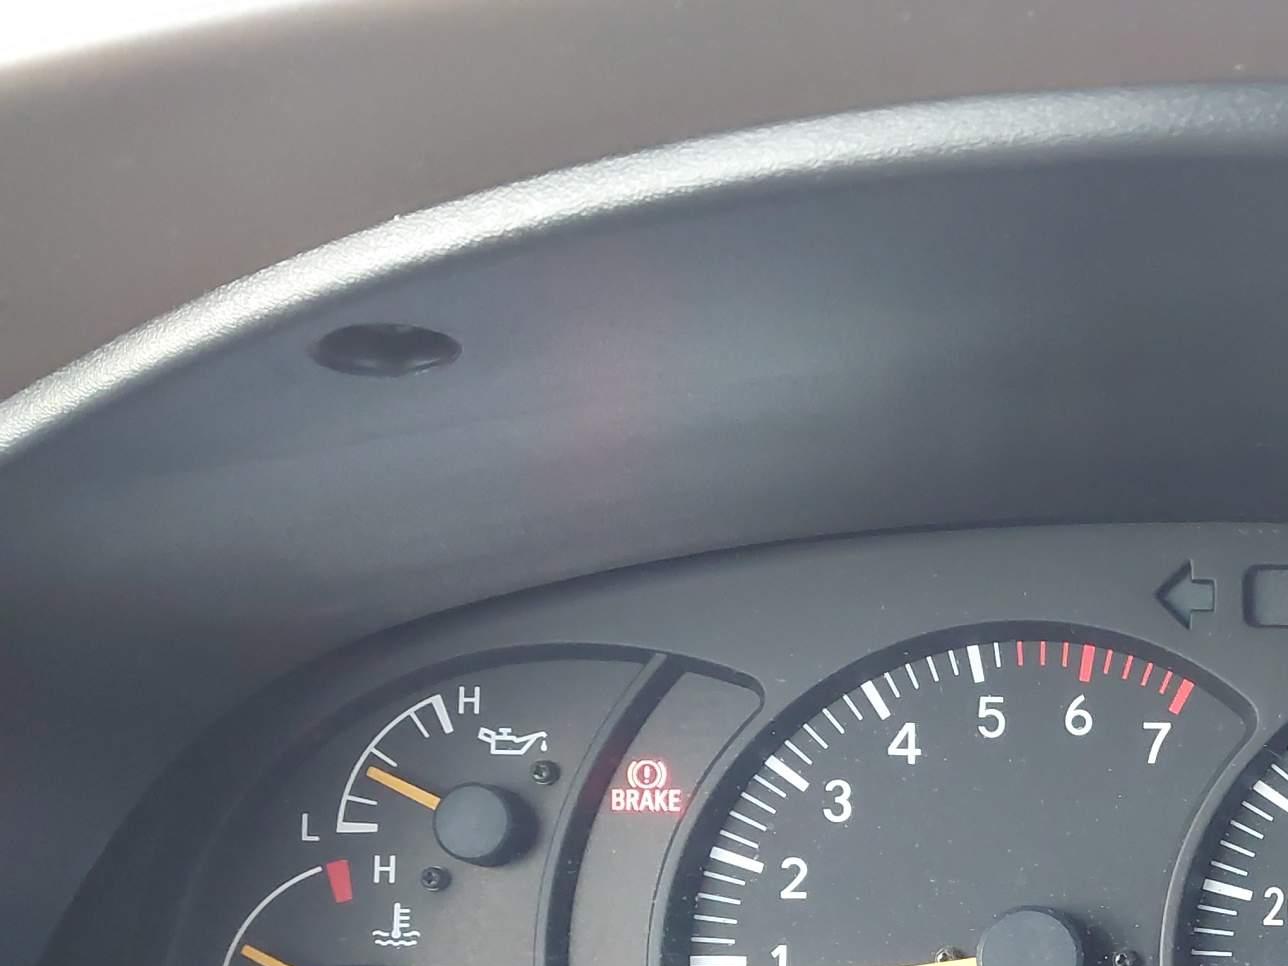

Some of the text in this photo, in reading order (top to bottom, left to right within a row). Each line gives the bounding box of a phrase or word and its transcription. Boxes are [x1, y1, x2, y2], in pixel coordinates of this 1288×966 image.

[459, 687, 480, 714] H
[979, 695, 1005, 738] 5
[1065, 695, 1092, 735] 6
[888, 723, 921, 764] 4
[1144, 722, 1171, 763] 7
[611, 788, 682, 812] BRAKE
[824, 780, 851, 822] 3
[302, 814, 320, 841] L
[374, 855, 395, 883] H
[781, 857, 807, 899] 2
